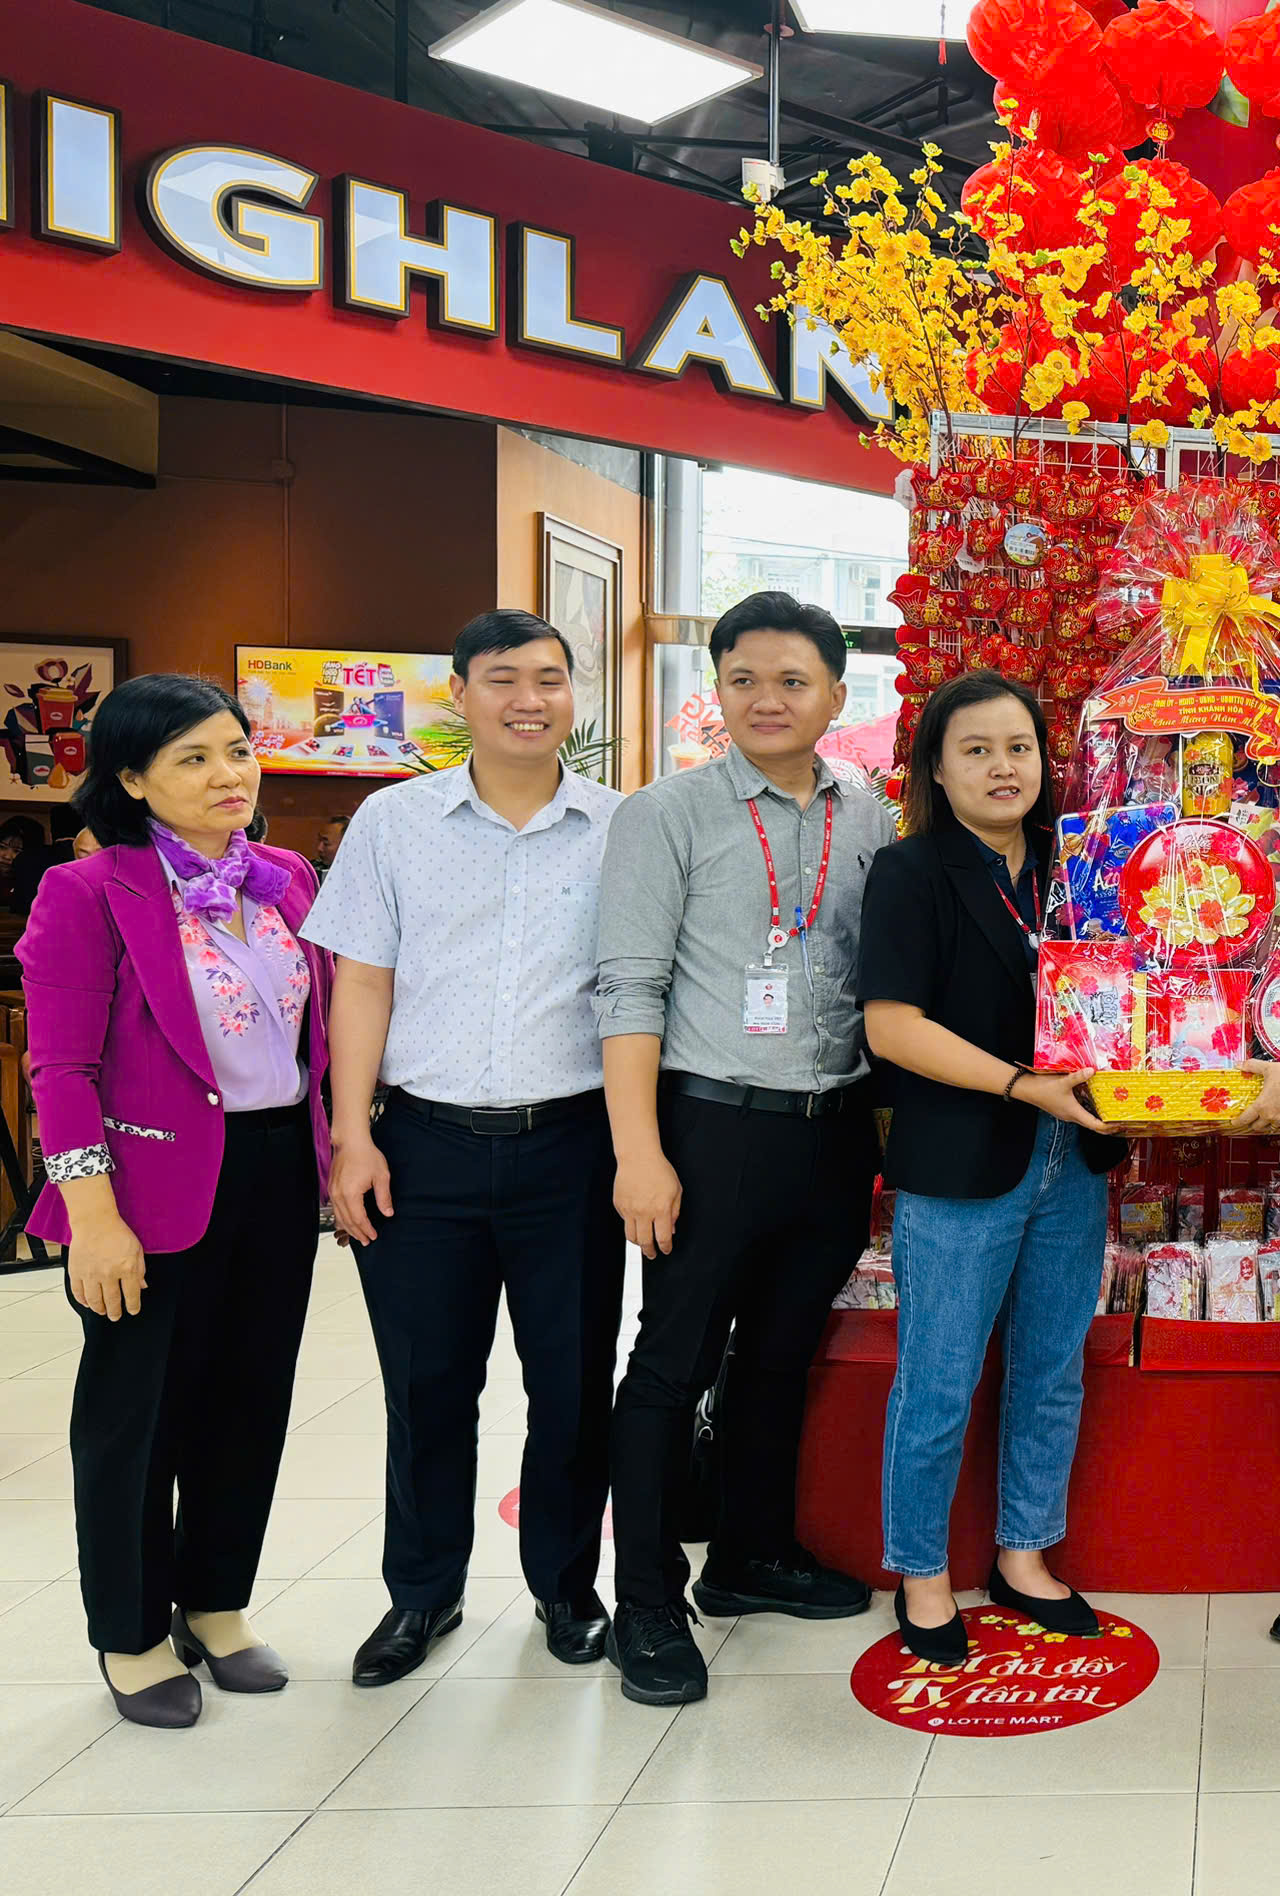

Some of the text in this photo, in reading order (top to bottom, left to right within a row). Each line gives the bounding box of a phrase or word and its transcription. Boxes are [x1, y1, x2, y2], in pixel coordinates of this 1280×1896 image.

[0, 76, 897, 425] IGHLAN
[248, 659, 292, 671] HDBank
[343, 661, 377, 686] TẾT
[1228, 705, 1244, 714] HÒA
[990, 1655, 1060, 1679] đủ
[1054, 1655, 1128, 1679] đầy
[888, 1675, 1118, 1714] Tỵ tấn tài
[948, 1716, 1063, 1725] LOTTE MART
